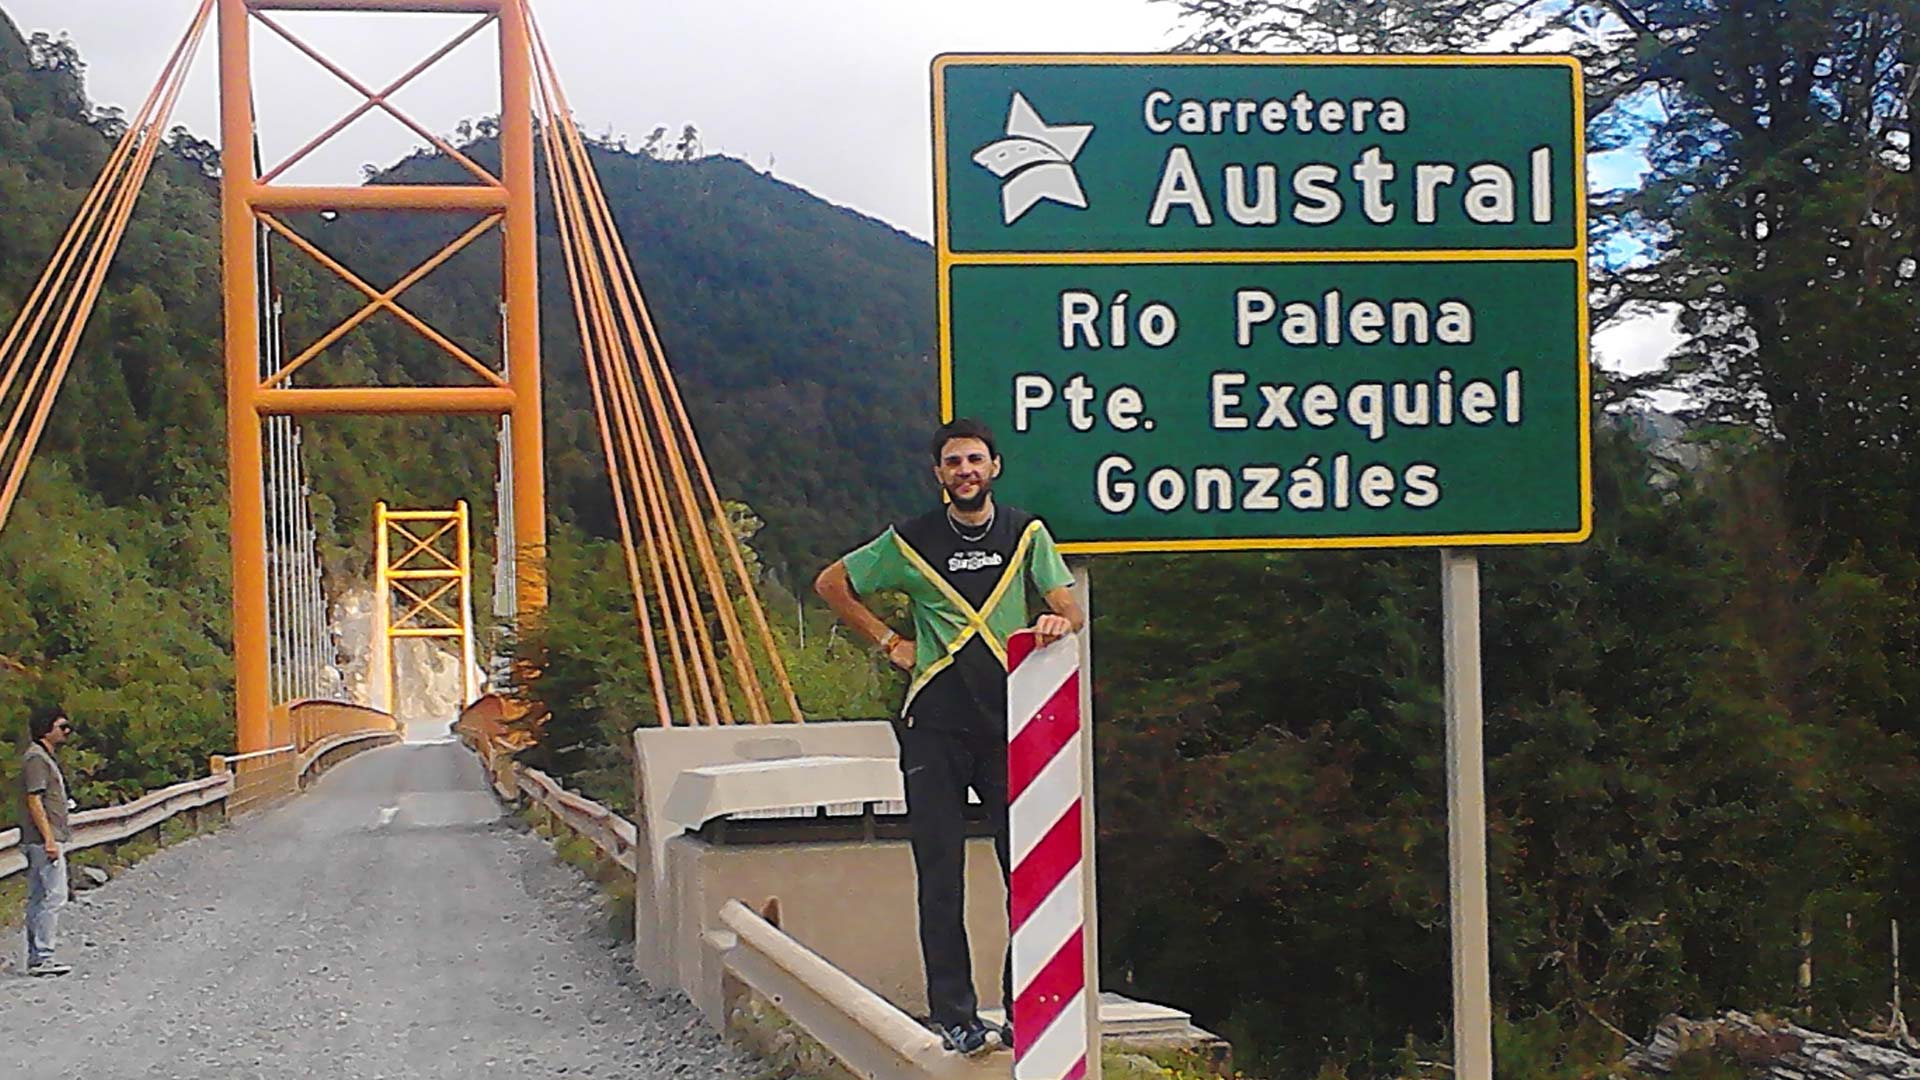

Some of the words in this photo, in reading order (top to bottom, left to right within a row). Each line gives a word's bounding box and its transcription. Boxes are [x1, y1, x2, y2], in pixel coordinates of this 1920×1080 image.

[1144, 91, 1405, 133] Carretera
[1149, 147, 1552, 225] Austral
[1062, 291, 1177, 348] Río
[1237, 290, 1472, 345] Palena
[1015, 376, 1155, 431] Pte.
[1212, 370, 1521, 440] Exequiel
[1097, 454, 1440, 513] Gonzáles
